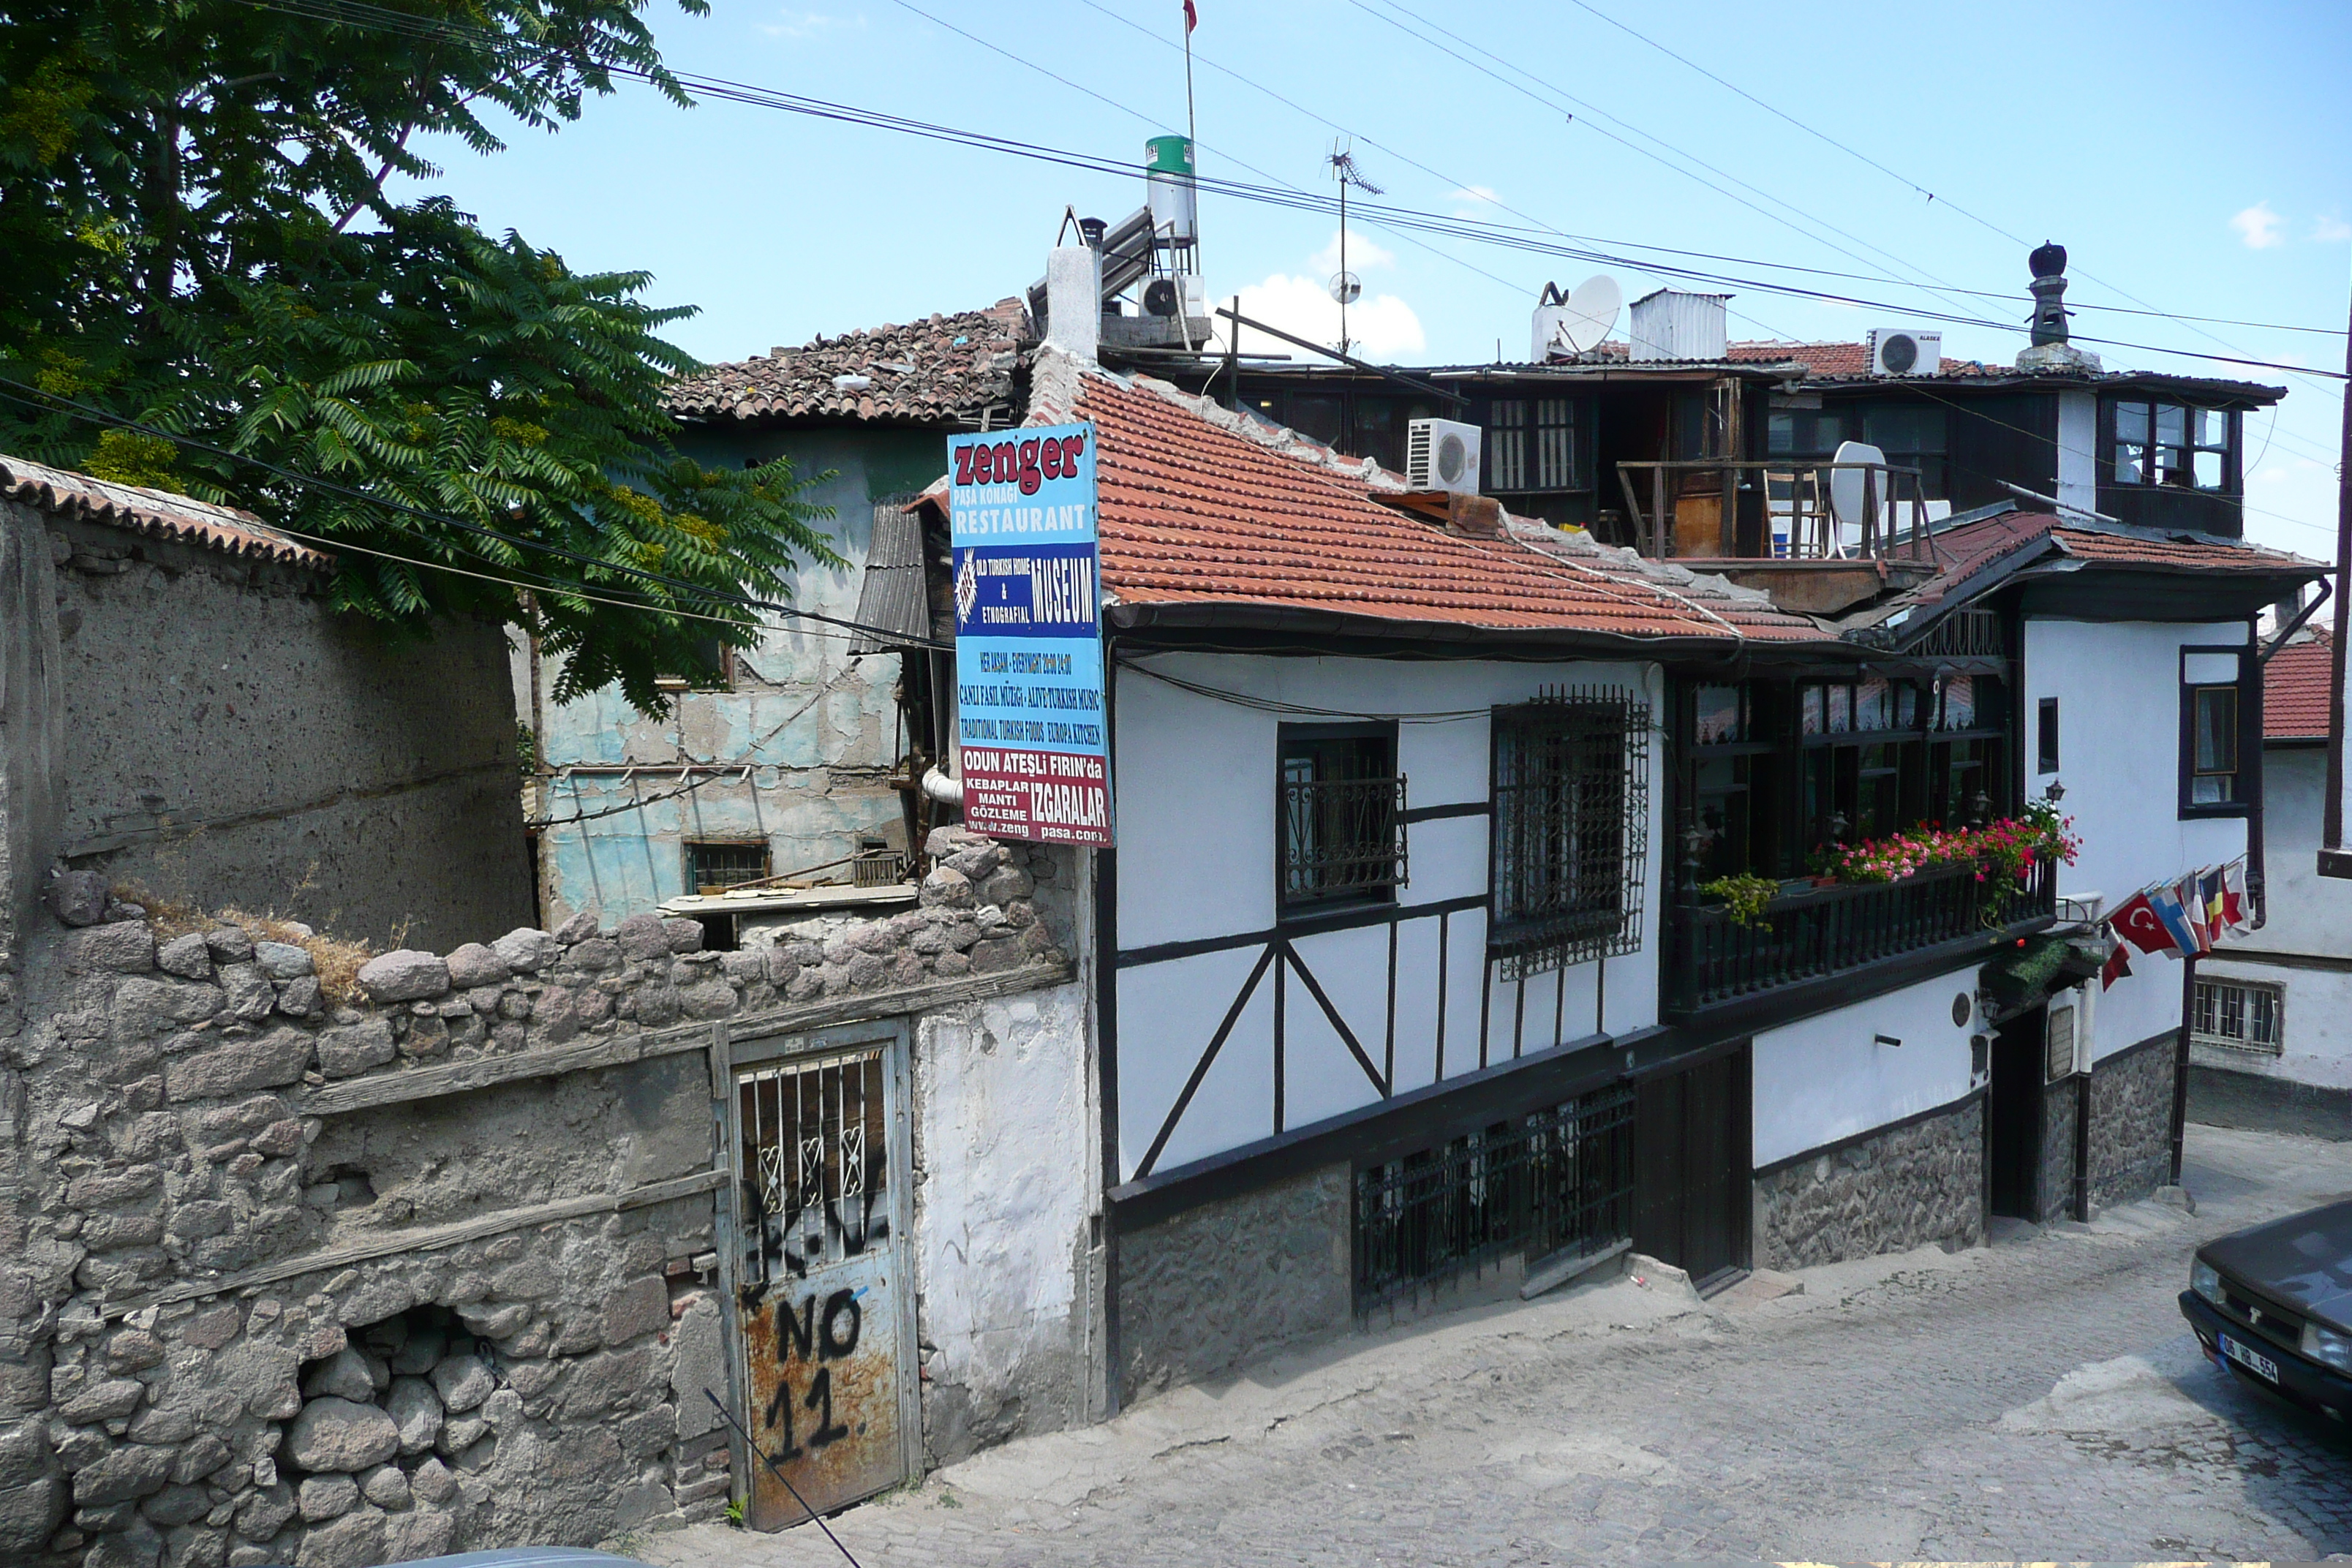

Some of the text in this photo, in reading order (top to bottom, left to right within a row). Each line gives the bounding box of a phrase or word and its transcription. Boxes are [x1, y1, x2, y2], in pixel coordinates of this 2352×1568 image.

[954, 434, 1085, 496] zenger
[954, 488, 978, 508] PAŞA
[955, 504, 1085, 535] RESTAURANT
[976, 557, 1030, 576] OLD TURKISH HOME
[1001, 582, 1008, 600] &
[1031, 557, 1093, 624] MUSEUM
[981, 606, 1030, 624] ETNOGRAFIAL
[959, 684, 979, 705] CANLI
[981, 685, 1000, 706] FASIL
[1047, 687, 1078, 710] TURKISH
[1078, 689, 1100, 712] MUSIC
[960, 718, 1101, 746] TRADITIONAL TURKISH FOODS EUROPA KITCHEN
[964, 750, 1000, 772] ODUN
[966, 777, 1029, 793] KEBAPLAR
[979, 793, 1017, 806] MANTI
[1030, 782, 1107, 827] IZGARALAR
[970, 805, 1028, 821] GÖZLEME
[777, 1288, 862, 1363] NO
